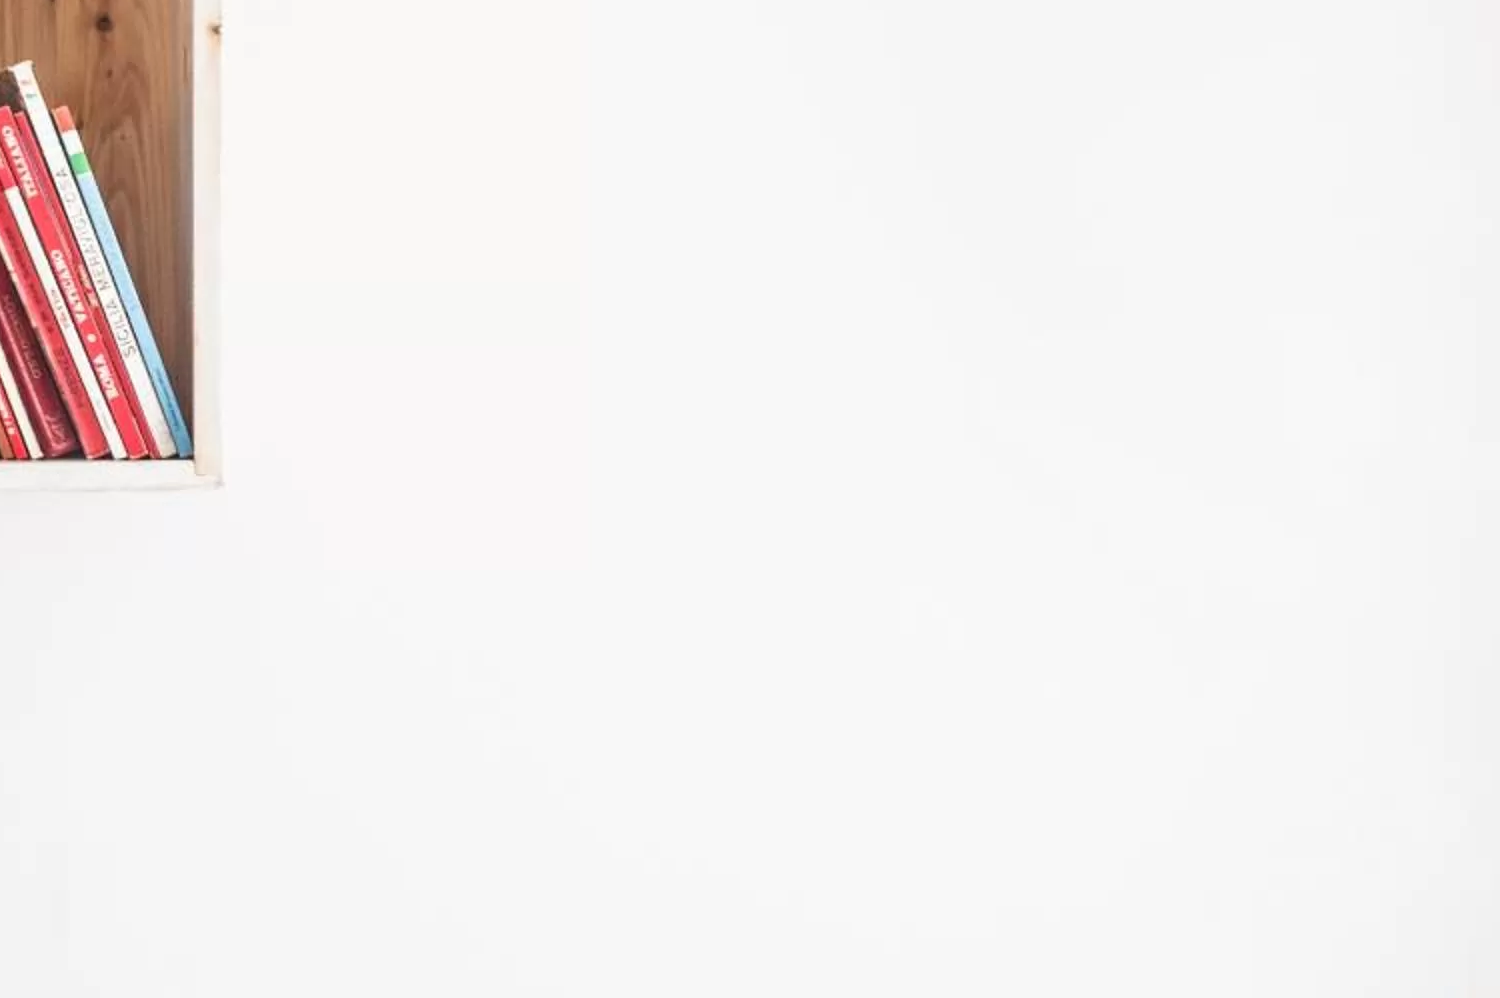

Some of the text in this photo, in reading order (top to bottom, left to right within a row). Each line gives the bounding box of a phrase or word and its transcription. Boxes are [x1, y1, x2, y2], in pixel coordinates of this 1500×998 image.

[1, 123, 38, 198] ITALIANO
[50, 247, 88, 323] VATICANO
[106, 299, 136, 358] SICILIA
[94, 353, 119, 399] ROMA
